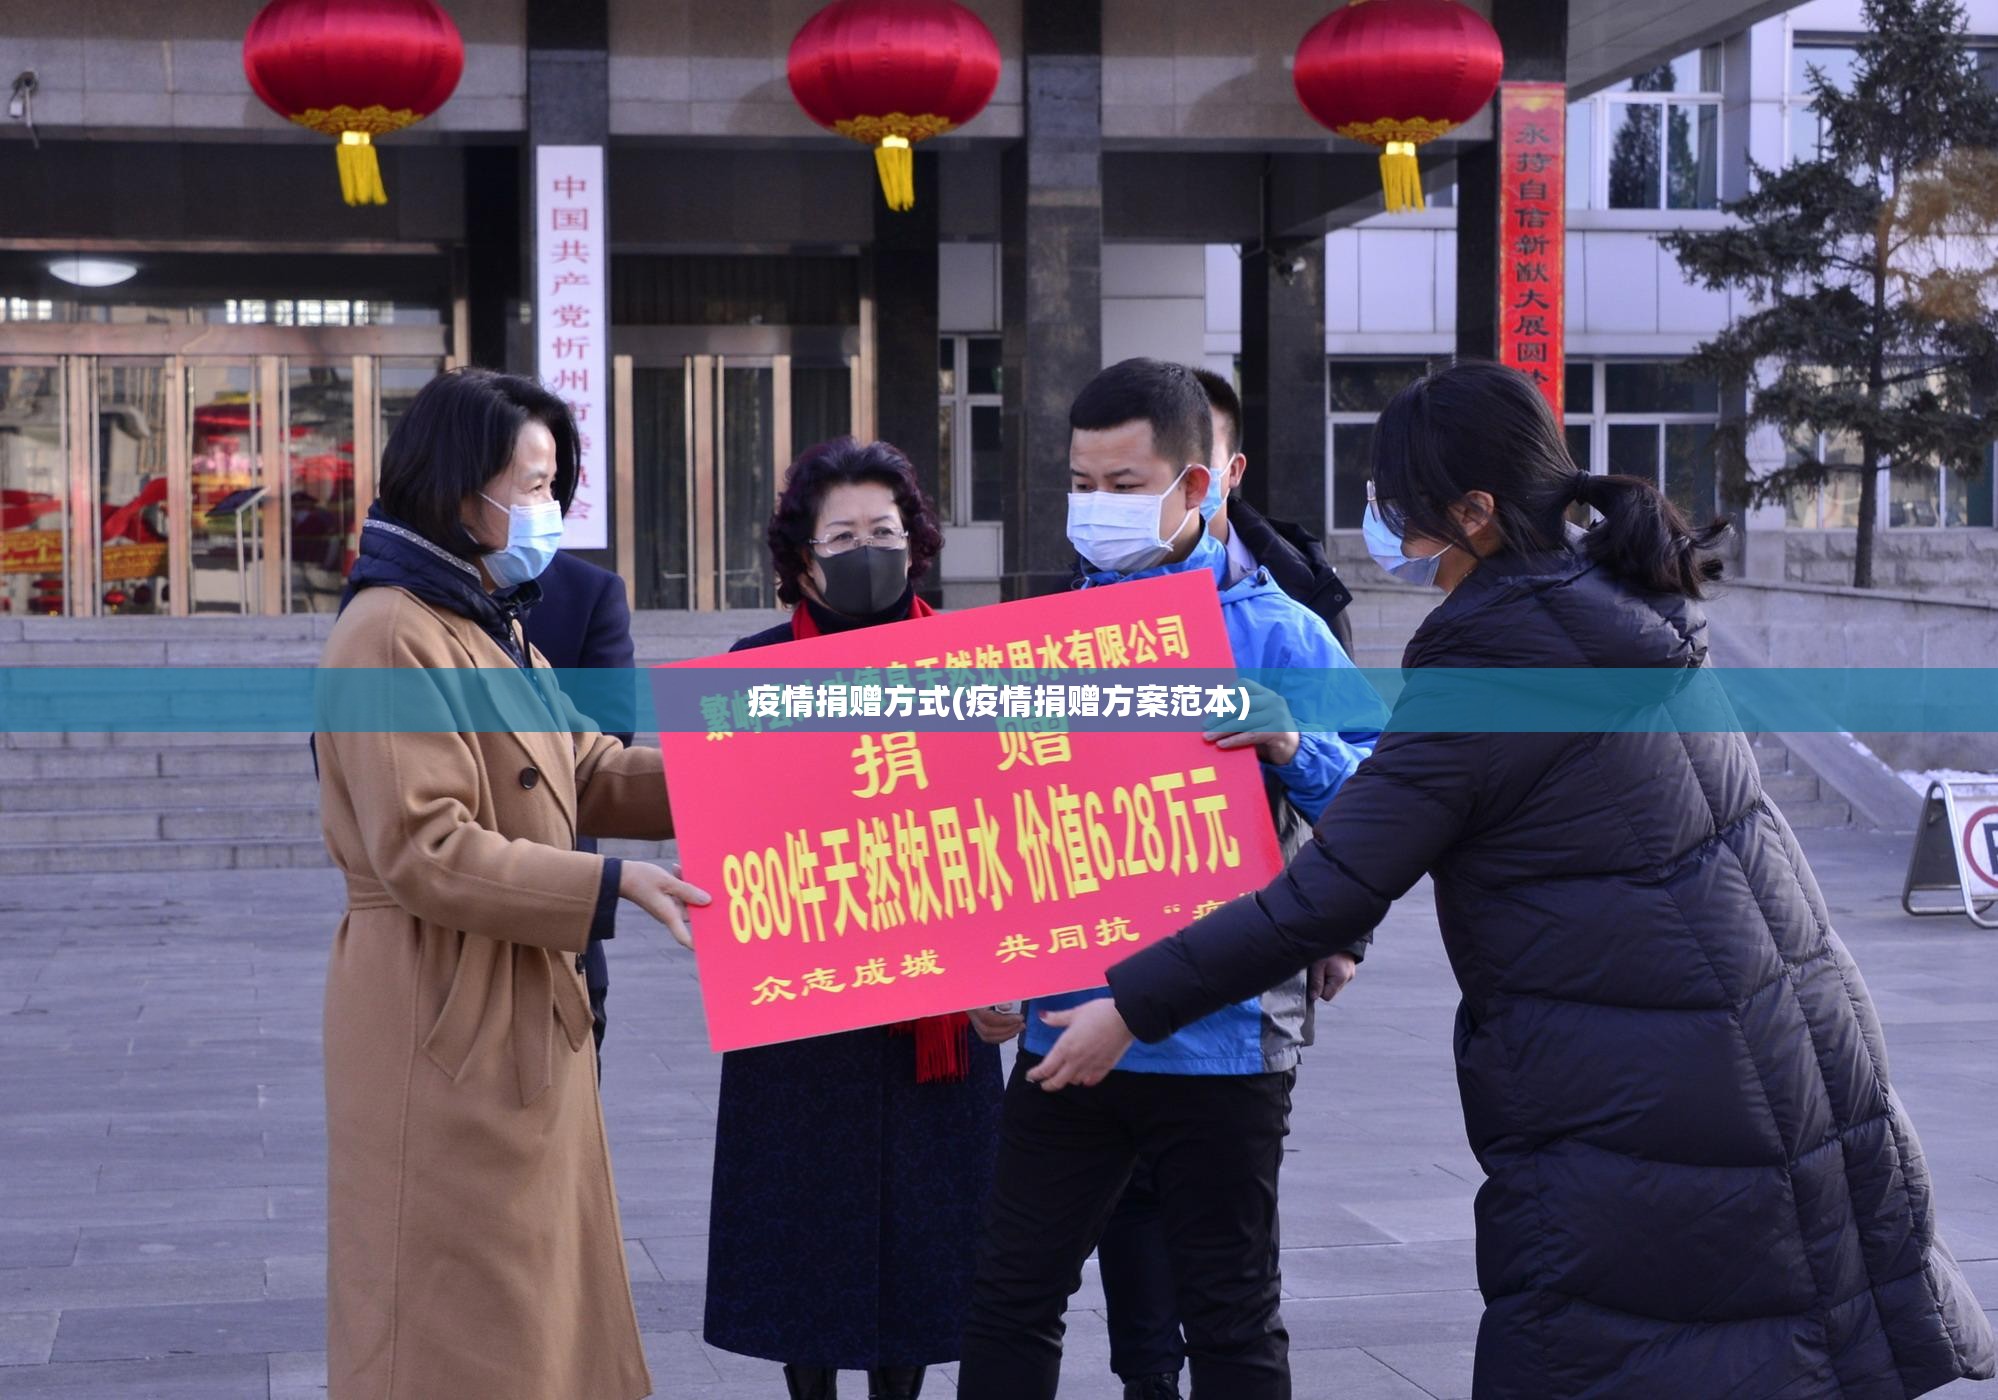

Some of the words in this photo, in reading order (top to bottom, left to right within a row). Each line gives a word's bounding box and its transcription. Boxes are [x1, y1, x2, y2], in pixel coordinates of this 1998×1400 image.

[850, 729, 929, 798] 捐
[995, 716, 1072, 771] 赠
[723, 798, 1013, 944] 880件天然饮用水
[1012, 766, 1240, 903] 价值6.28万元
[751, 949, 946, 1005] 众志成城
